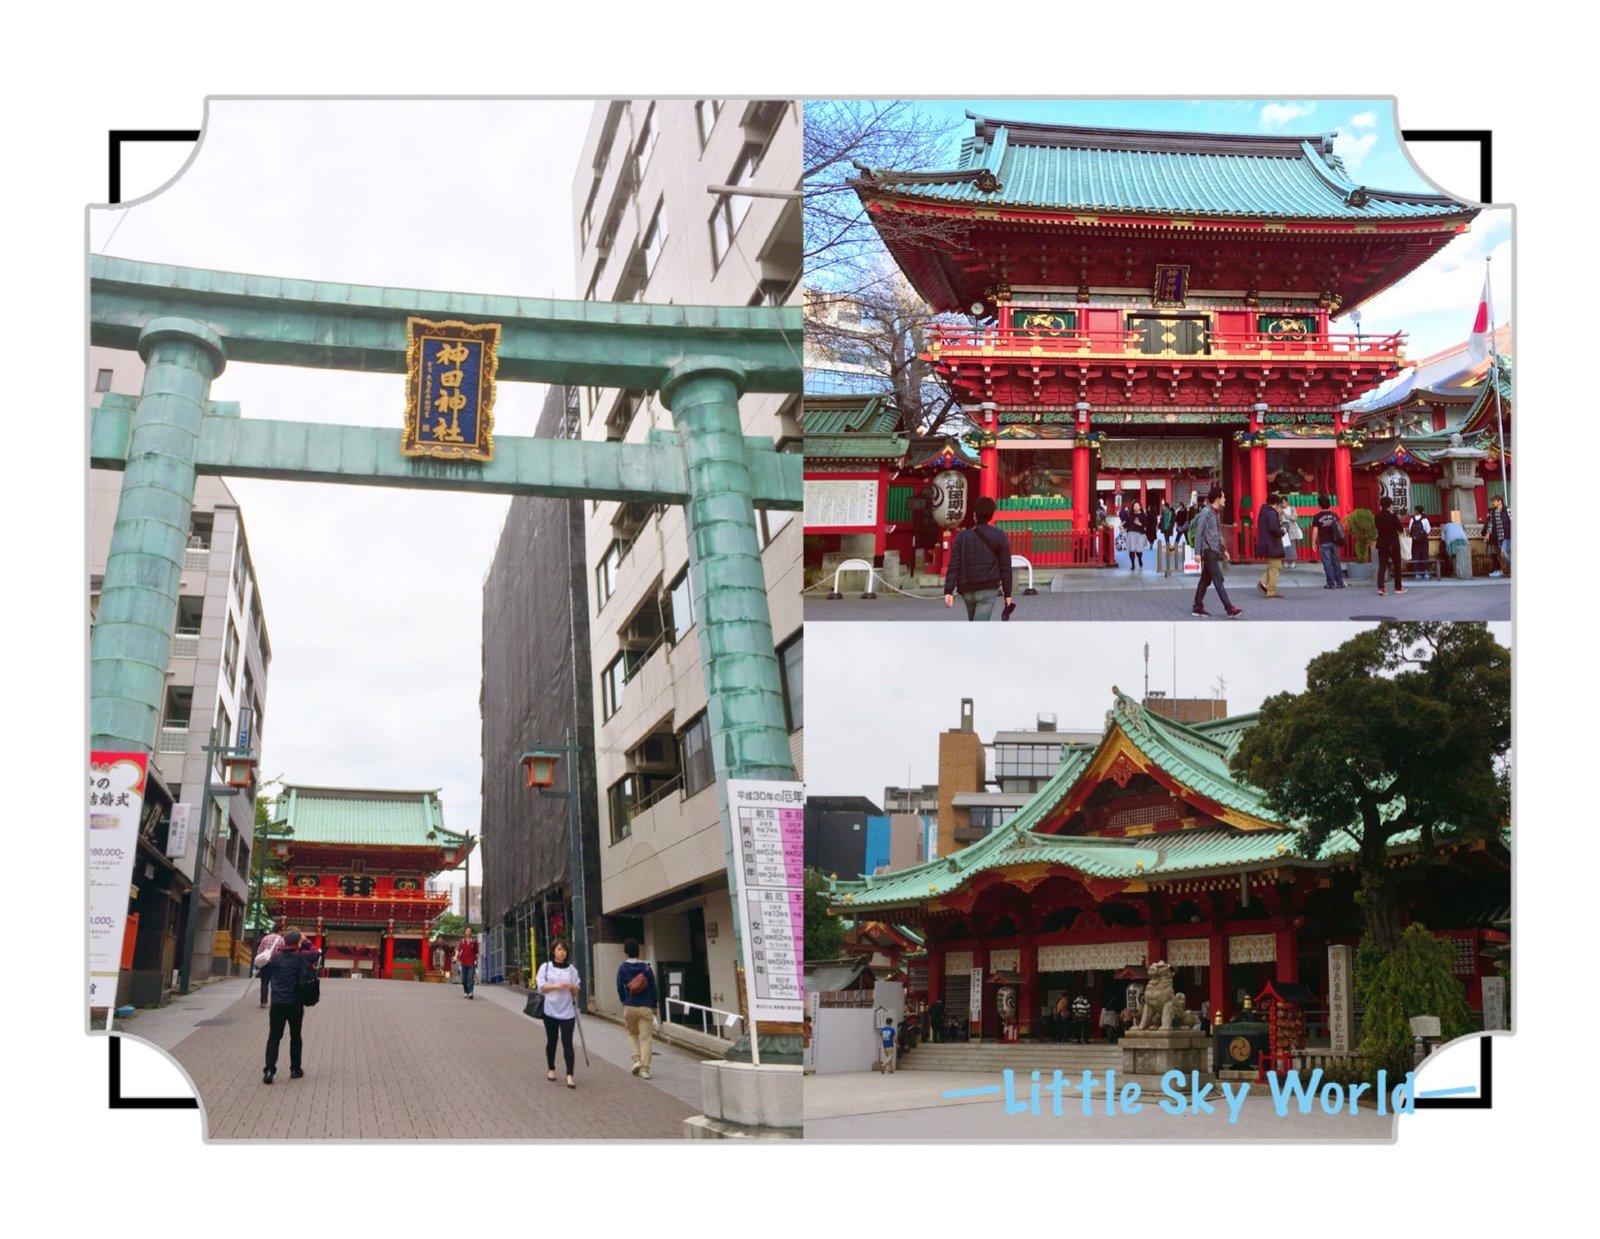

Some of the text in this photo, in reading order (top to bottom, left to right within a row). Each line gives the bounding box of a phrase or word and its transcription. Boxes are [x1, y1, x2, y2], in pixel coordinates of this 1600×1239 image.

[432, 341, 470, 442] 神田神社
[946, 475, 964, 521] 神田明神
[737, 790, 803, 803] 平成30年の厄年
[743, 826, 755, 876] 男の厄年
[752, 922, 765, 974] 女の厄年
